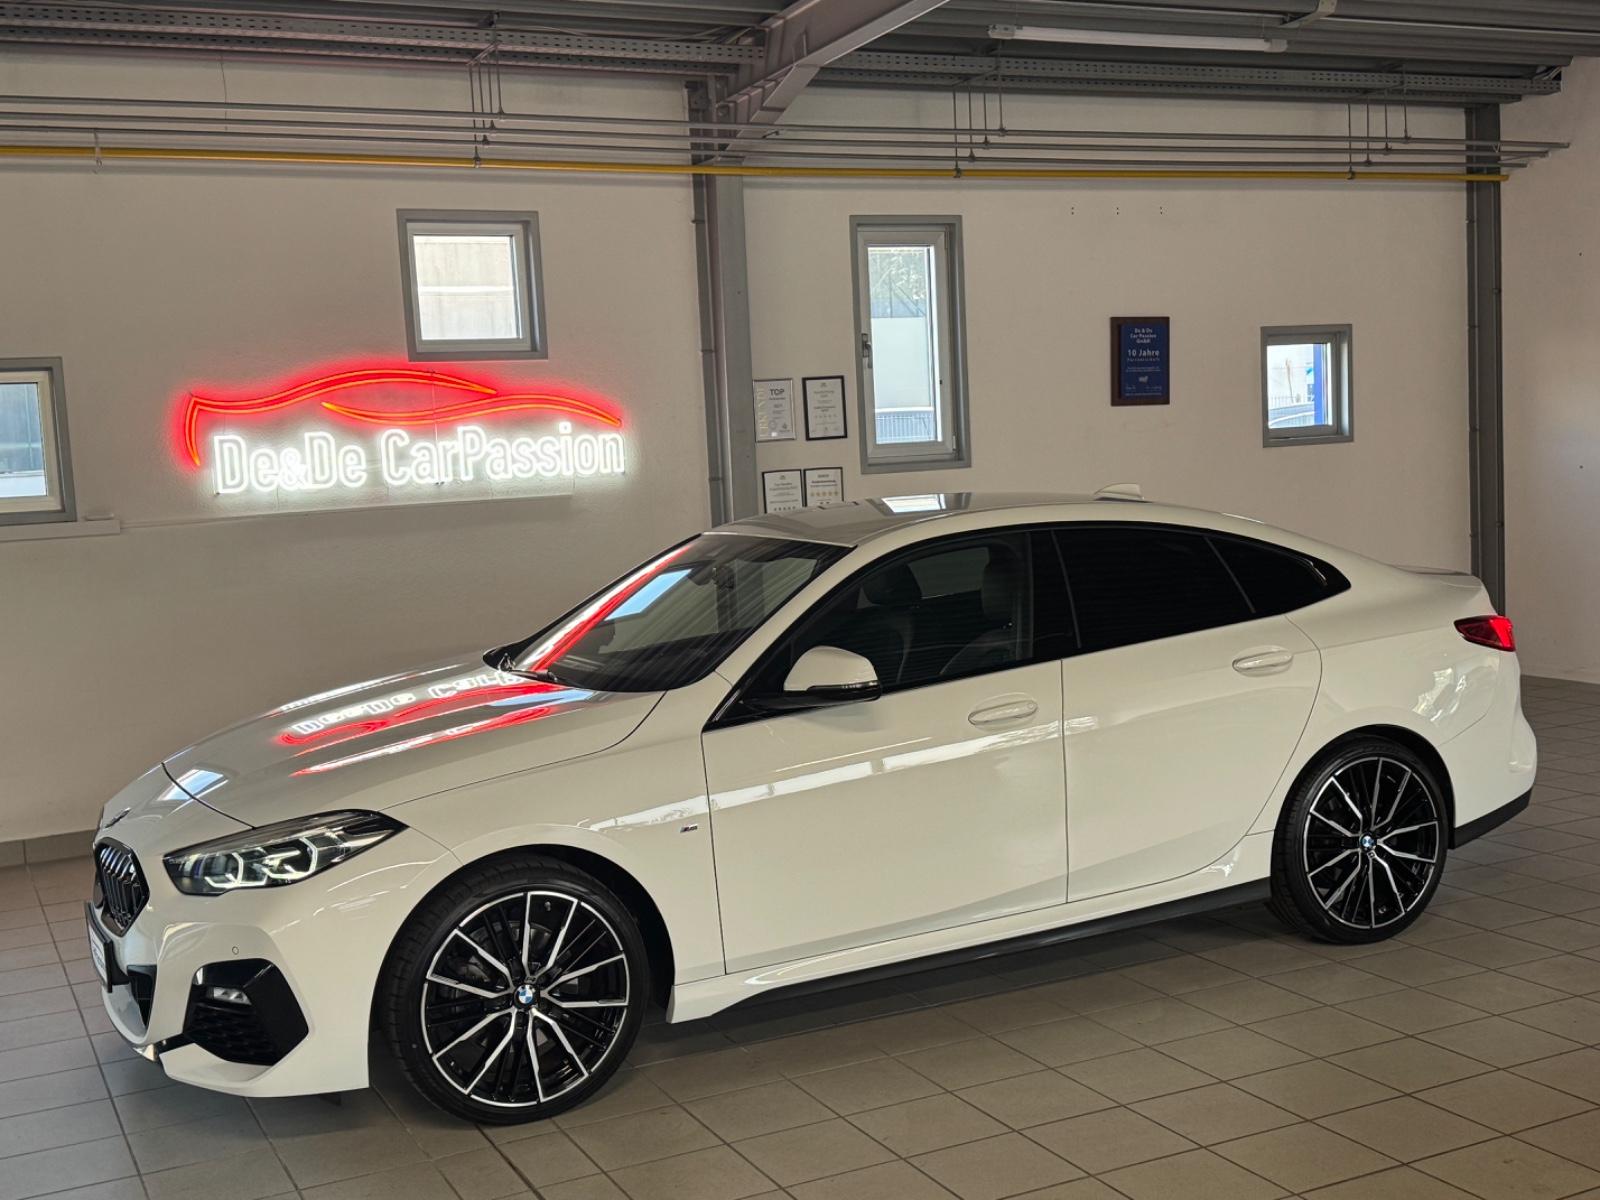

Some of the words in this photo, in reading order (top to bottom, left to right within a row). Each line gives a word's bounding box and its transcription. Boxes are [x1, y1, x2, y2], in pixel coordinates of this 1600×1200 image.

[1127, 349, 1137, 357] 10
[1139, 349, 1160, 357] Jahre
[769, 388, 785, 396] TOP
[213, 434, 367, 494] De&De
[380, 422, 625, 486] CarPassion
